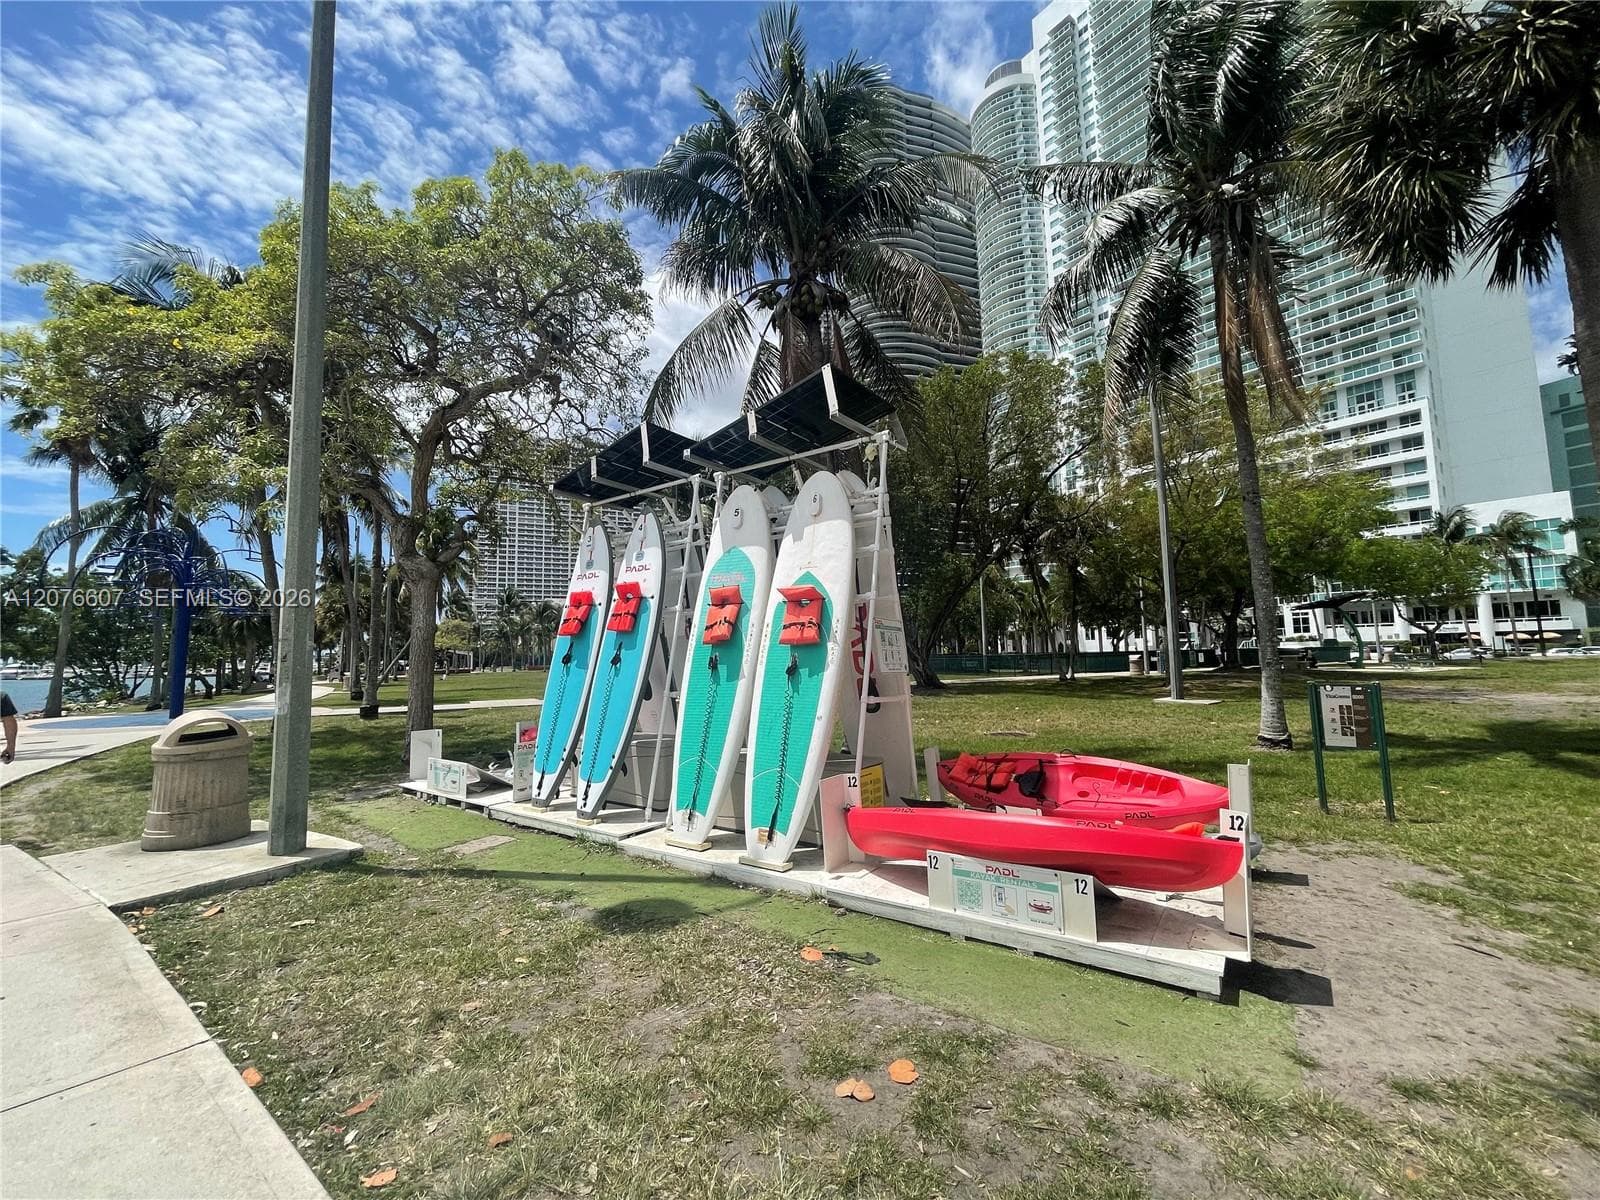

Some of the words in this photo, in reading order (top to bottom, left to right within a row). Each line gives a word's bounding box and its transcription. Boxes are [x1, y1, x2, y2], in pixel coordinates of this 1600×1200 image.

[813, 495, 818, 503] 6
[733, 508, 740, 517] 5
[625, 564, 650, 574] PADL
[576, 572, 600, 581] PADL
[847, 776, 858, 788] 12
[1124, 811, 1155, 820] PADL
[1076, 820, 1118, 830] PADL
[1229, 814, 1245, 832] 12
[928, 855, 939, 870] 12
[985, 865, 1021, 878] PADL
[970, 871, 996, 882] KAYAK
[1000, 876, 1038, 889] RENTALS
[1074, 878, 1089, 896] 12
